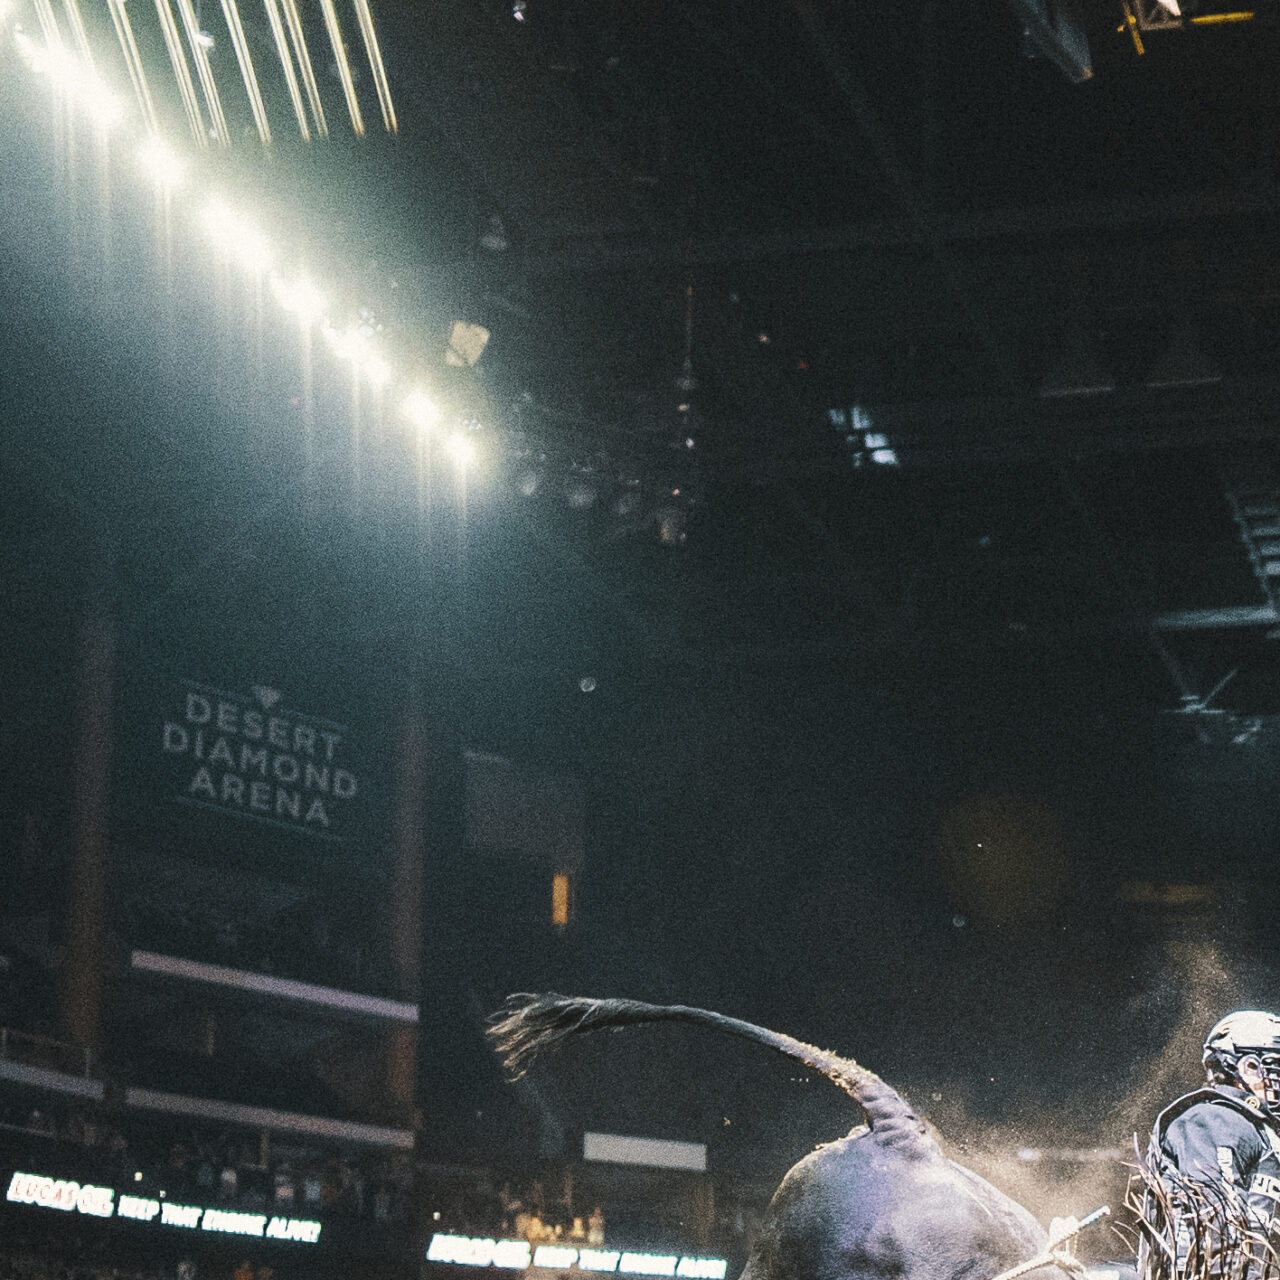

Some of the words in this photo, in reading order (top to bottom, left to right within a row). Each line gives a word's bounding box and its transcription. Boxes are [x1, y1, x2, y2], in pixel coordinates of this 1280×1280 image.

[186, 693, 341, 760] DESERT
[163, 721, 357, 799] DIAMOND
[190, 767, 329, 826] ARENA
[6, 1172, 80, 1211] LUCAS
